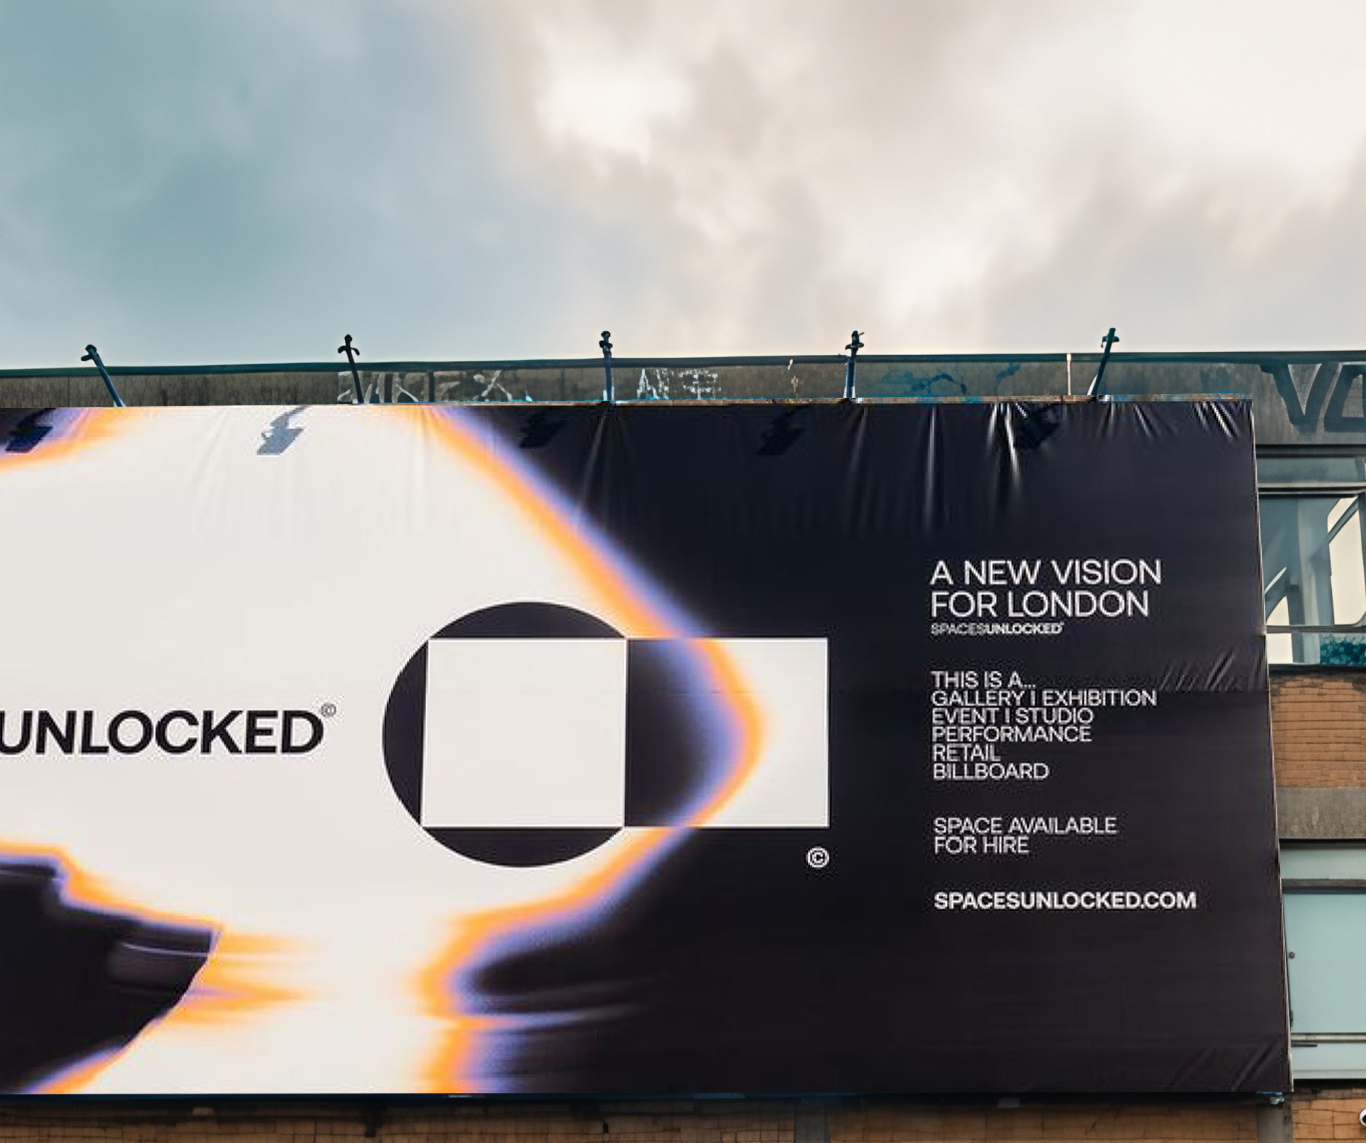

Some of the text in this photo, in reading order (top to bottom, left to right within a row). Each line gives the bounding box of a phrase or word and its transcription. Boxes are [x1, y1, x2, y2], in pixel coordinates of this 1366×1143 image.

[930, 559, 1162, 585] A NEW VISION
[931, 590, 1149, 618] FOR LONDON
[931, 671, 978, 688] THIS
[984, 671, 1002, 688] IS
[931, 690, 1023, 706] GALLERY
[1043, 689, 1157, 706] EXHIBITION
[932, 708, 1000, 725] EVENT
[1015, 708, 1094, 725] STUDIO
[932, 727, 1092, 742] PERFORMANCE
[932, 744, 1001, 762] RETAIL
[933, 763, 1049, 780] BILLBOARD
[933, 816, 1117, 835] SPACE AVAILABLE
[934, 836, 1030, 854] FOR HIRE
[934, 891, 1197, 910] SPACESUNLOCKED.COM
